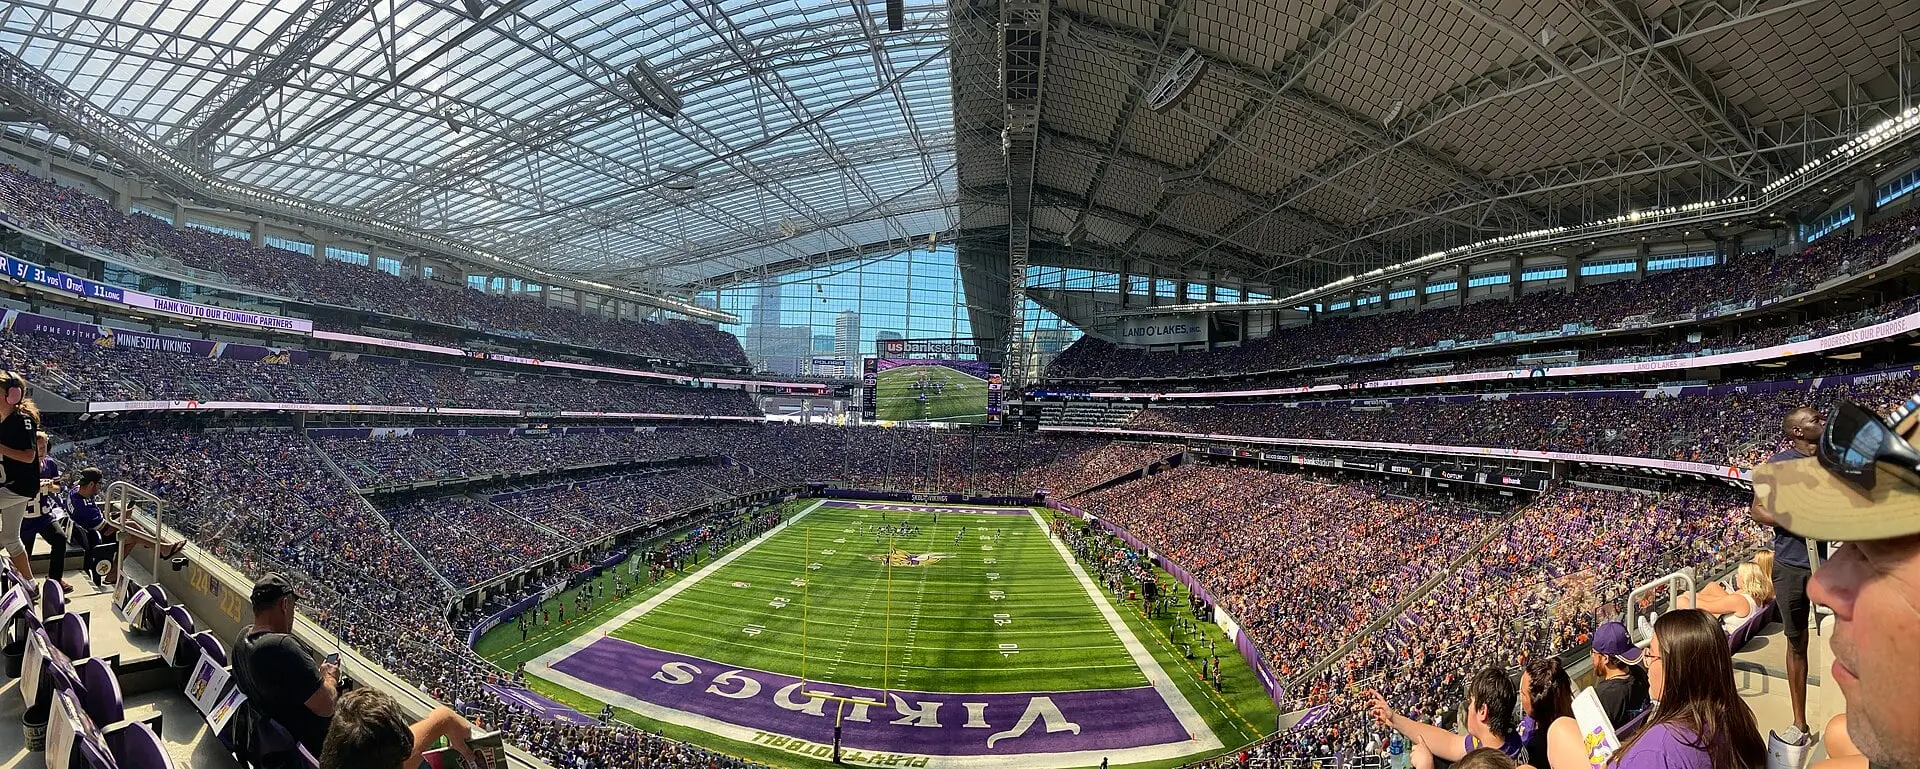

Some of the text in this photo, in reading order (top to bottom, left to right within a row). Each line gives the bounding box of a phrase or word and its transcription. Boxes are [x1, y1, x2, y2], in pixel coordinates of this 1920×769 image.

[154, 299, 293, 329] THANK YOU TO OUR FOUNDING PARTNERS
[36, 323, 96, 340] HOME OF THE
[1122, 327, 1145, 337] LAND
[1820, 333, 1850, 349] PROGRESS
[1851, 333, 1858, 343] IS
[1860, 328, 1874, 341] OUR
[116, 333, 191, 353] MINNESOTA VIKINGS
[1633, 363, 1650, 371] LAND
[1853, 373, 1881, 386] MINNESOTA
[24, 419, 32, 430] 5
[650, 660, 1081, 750] VIKINGS
[484, 746, 496, 769] THE
